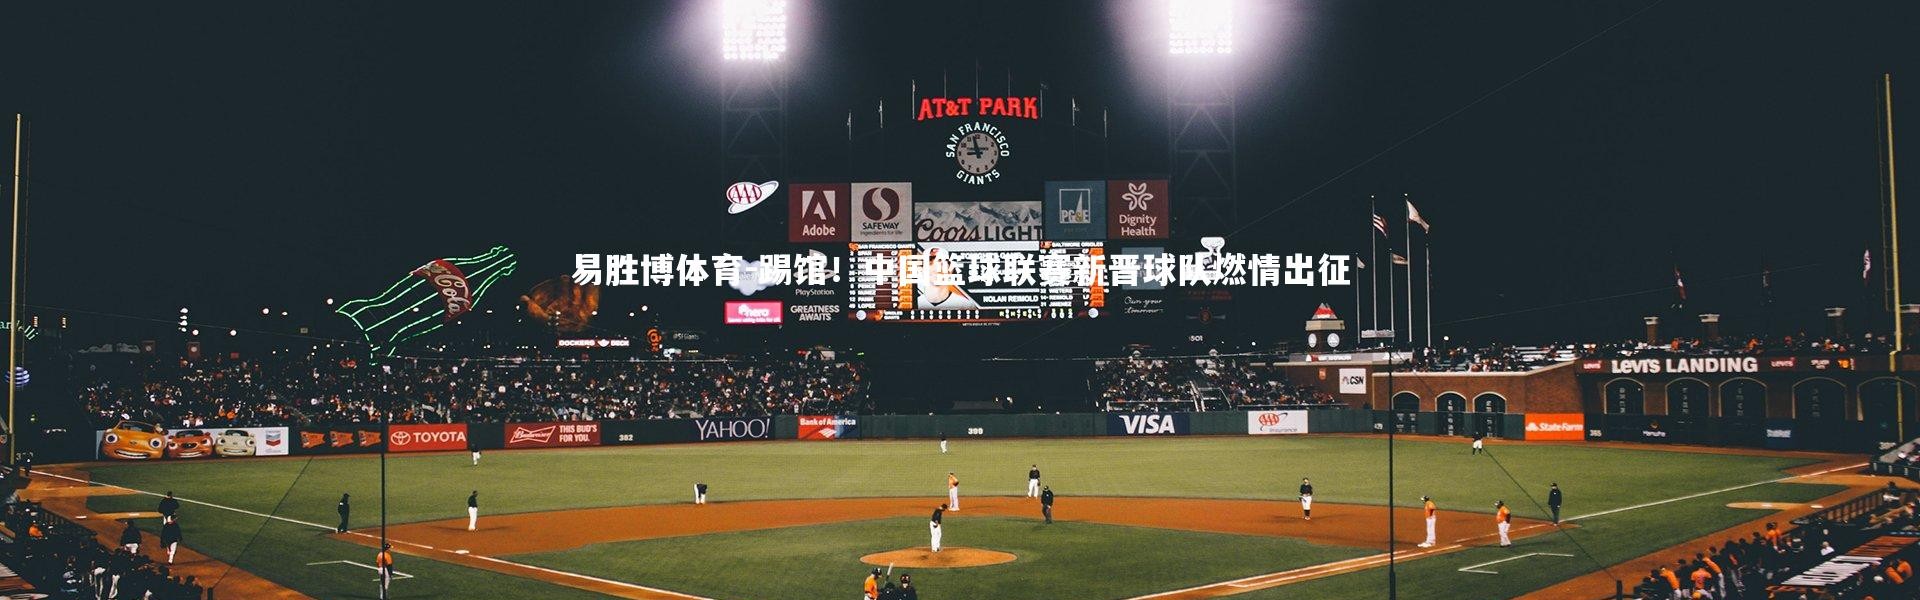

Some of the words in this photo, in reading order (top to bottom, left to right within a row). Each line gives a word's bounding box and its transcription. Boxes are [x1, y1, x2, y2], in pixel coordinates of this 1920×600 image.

[917, 97, 972, 121] AT&T
[979, 97, 1038, 119] PARK
[945, 134, 960, 158] SAN
[957, 121, 1010, 157] FRANCISCO
[956, 168, 1001, 185] GIANTS
[1061, 209, 1090, 222] PG&E
[1119, 214, 1157, 226] Dignity
[802, 225, 835, 236] Adobe
[862, 222, 900, 230] SAFEWAY
[916, 219, 981, 241] Coors
[984, 225, 1042, 241] LIGHT
[1121, 226, 1156, 236] Health
[434, 274, 471, 315] Cola
[795, 289, 835, 297] PlayStation
[790, 305, 840, 313] GREATNESS
[799, 313, 832, 321] AWAITS
[1665, 357, 1758, 373] LANDING
[1350, 376, 1364, 385] CSN
[800, 418, 818, 426] Bank
[819, 418, 827, 426] of
[827, 418, 856, 426] America
[1119, 415, 1175, 434] VISA
[560, 425, 575, 433] THIS
[577, 425, 597, 433] BUD'S
[695, 418, 771, 440] YAHOO!
[413, 431, 466, 443] TOYOTA
[560, 434, 573, 442] FOR
[574, 434, 590, 442] YOU.
